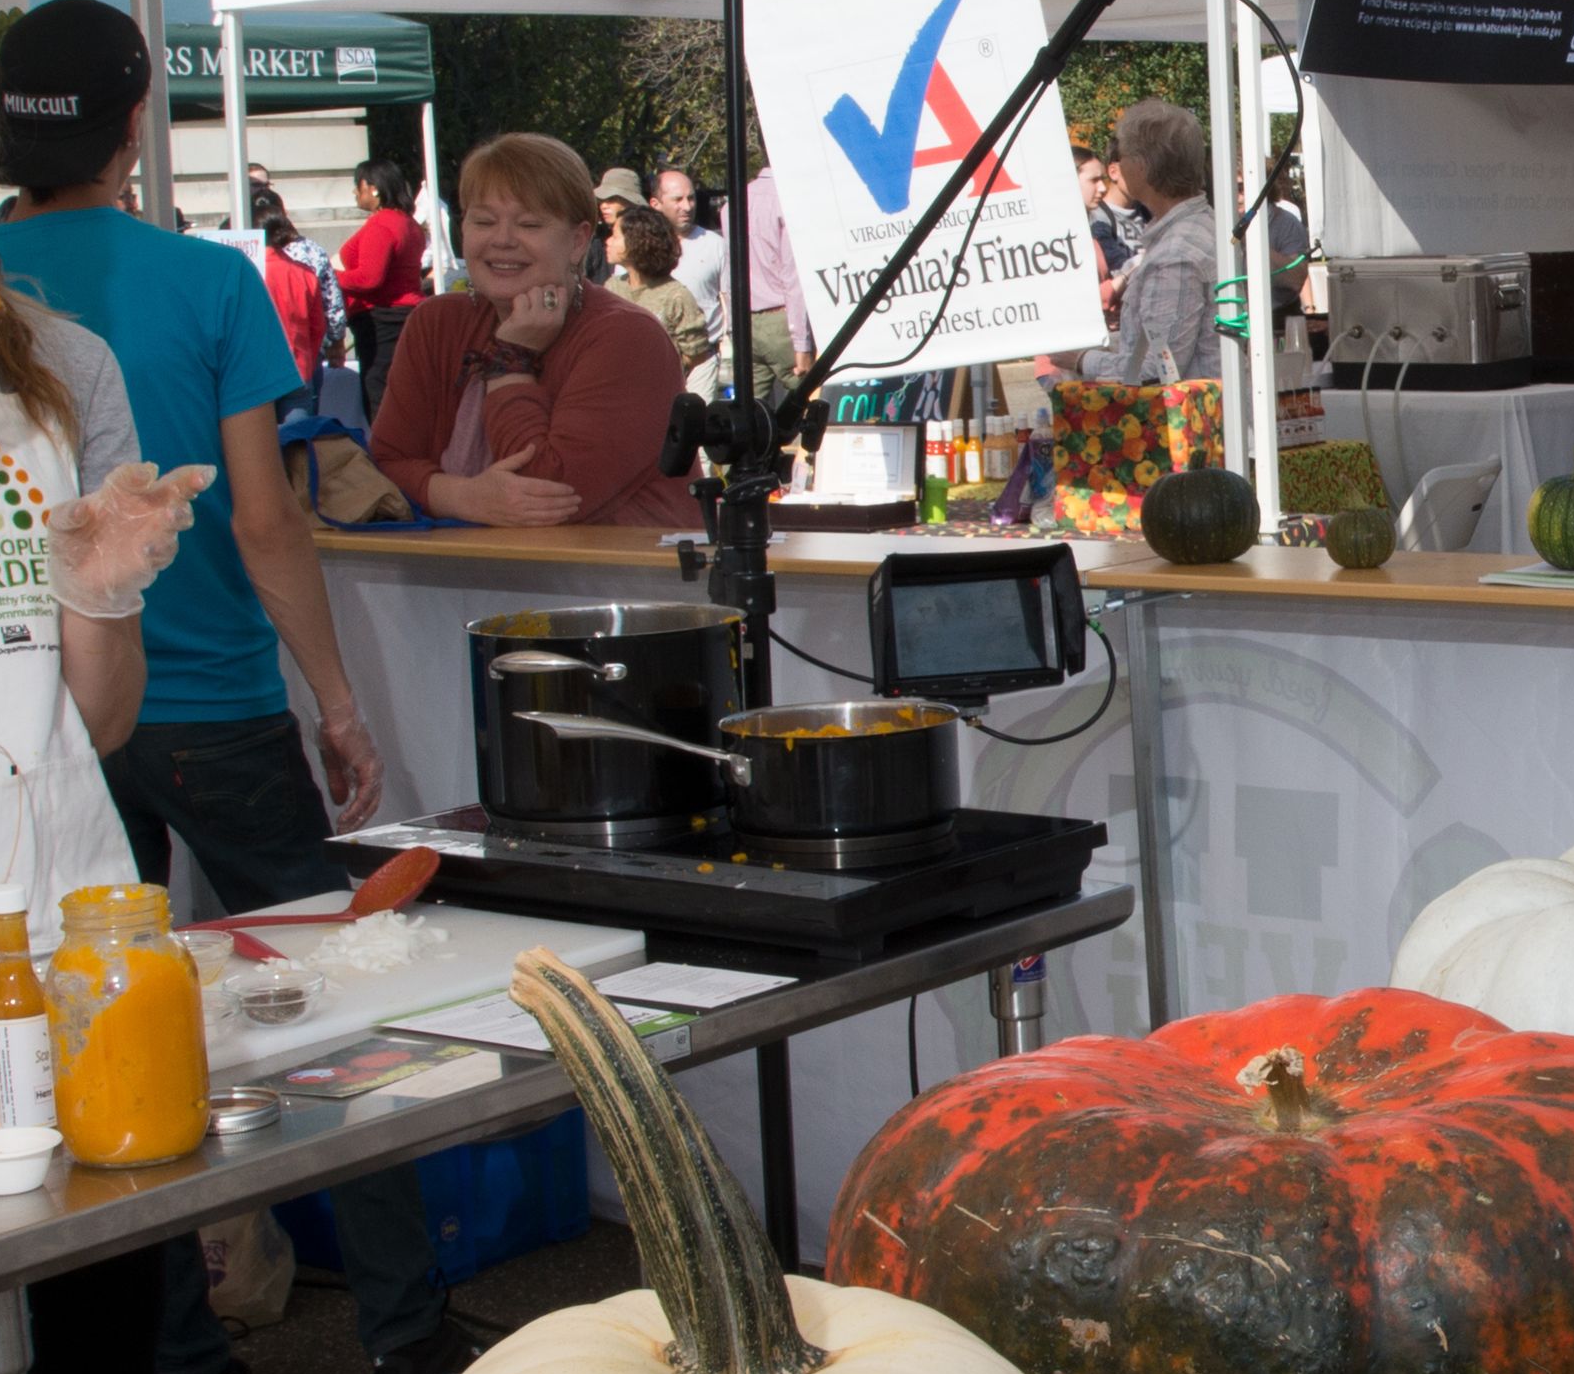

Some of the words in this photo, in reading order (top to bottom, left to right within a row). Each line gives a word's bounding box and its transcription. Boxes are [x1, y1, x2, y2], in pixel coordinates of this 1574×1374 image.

[336, 48, 376, 66] USDA
[3, 94, 38, 114] MILK
[38, 95, 81, 116] CULT
[973, 228, 1083, 284] Finest
[890, 301, 1041, 340] vafinest.com
